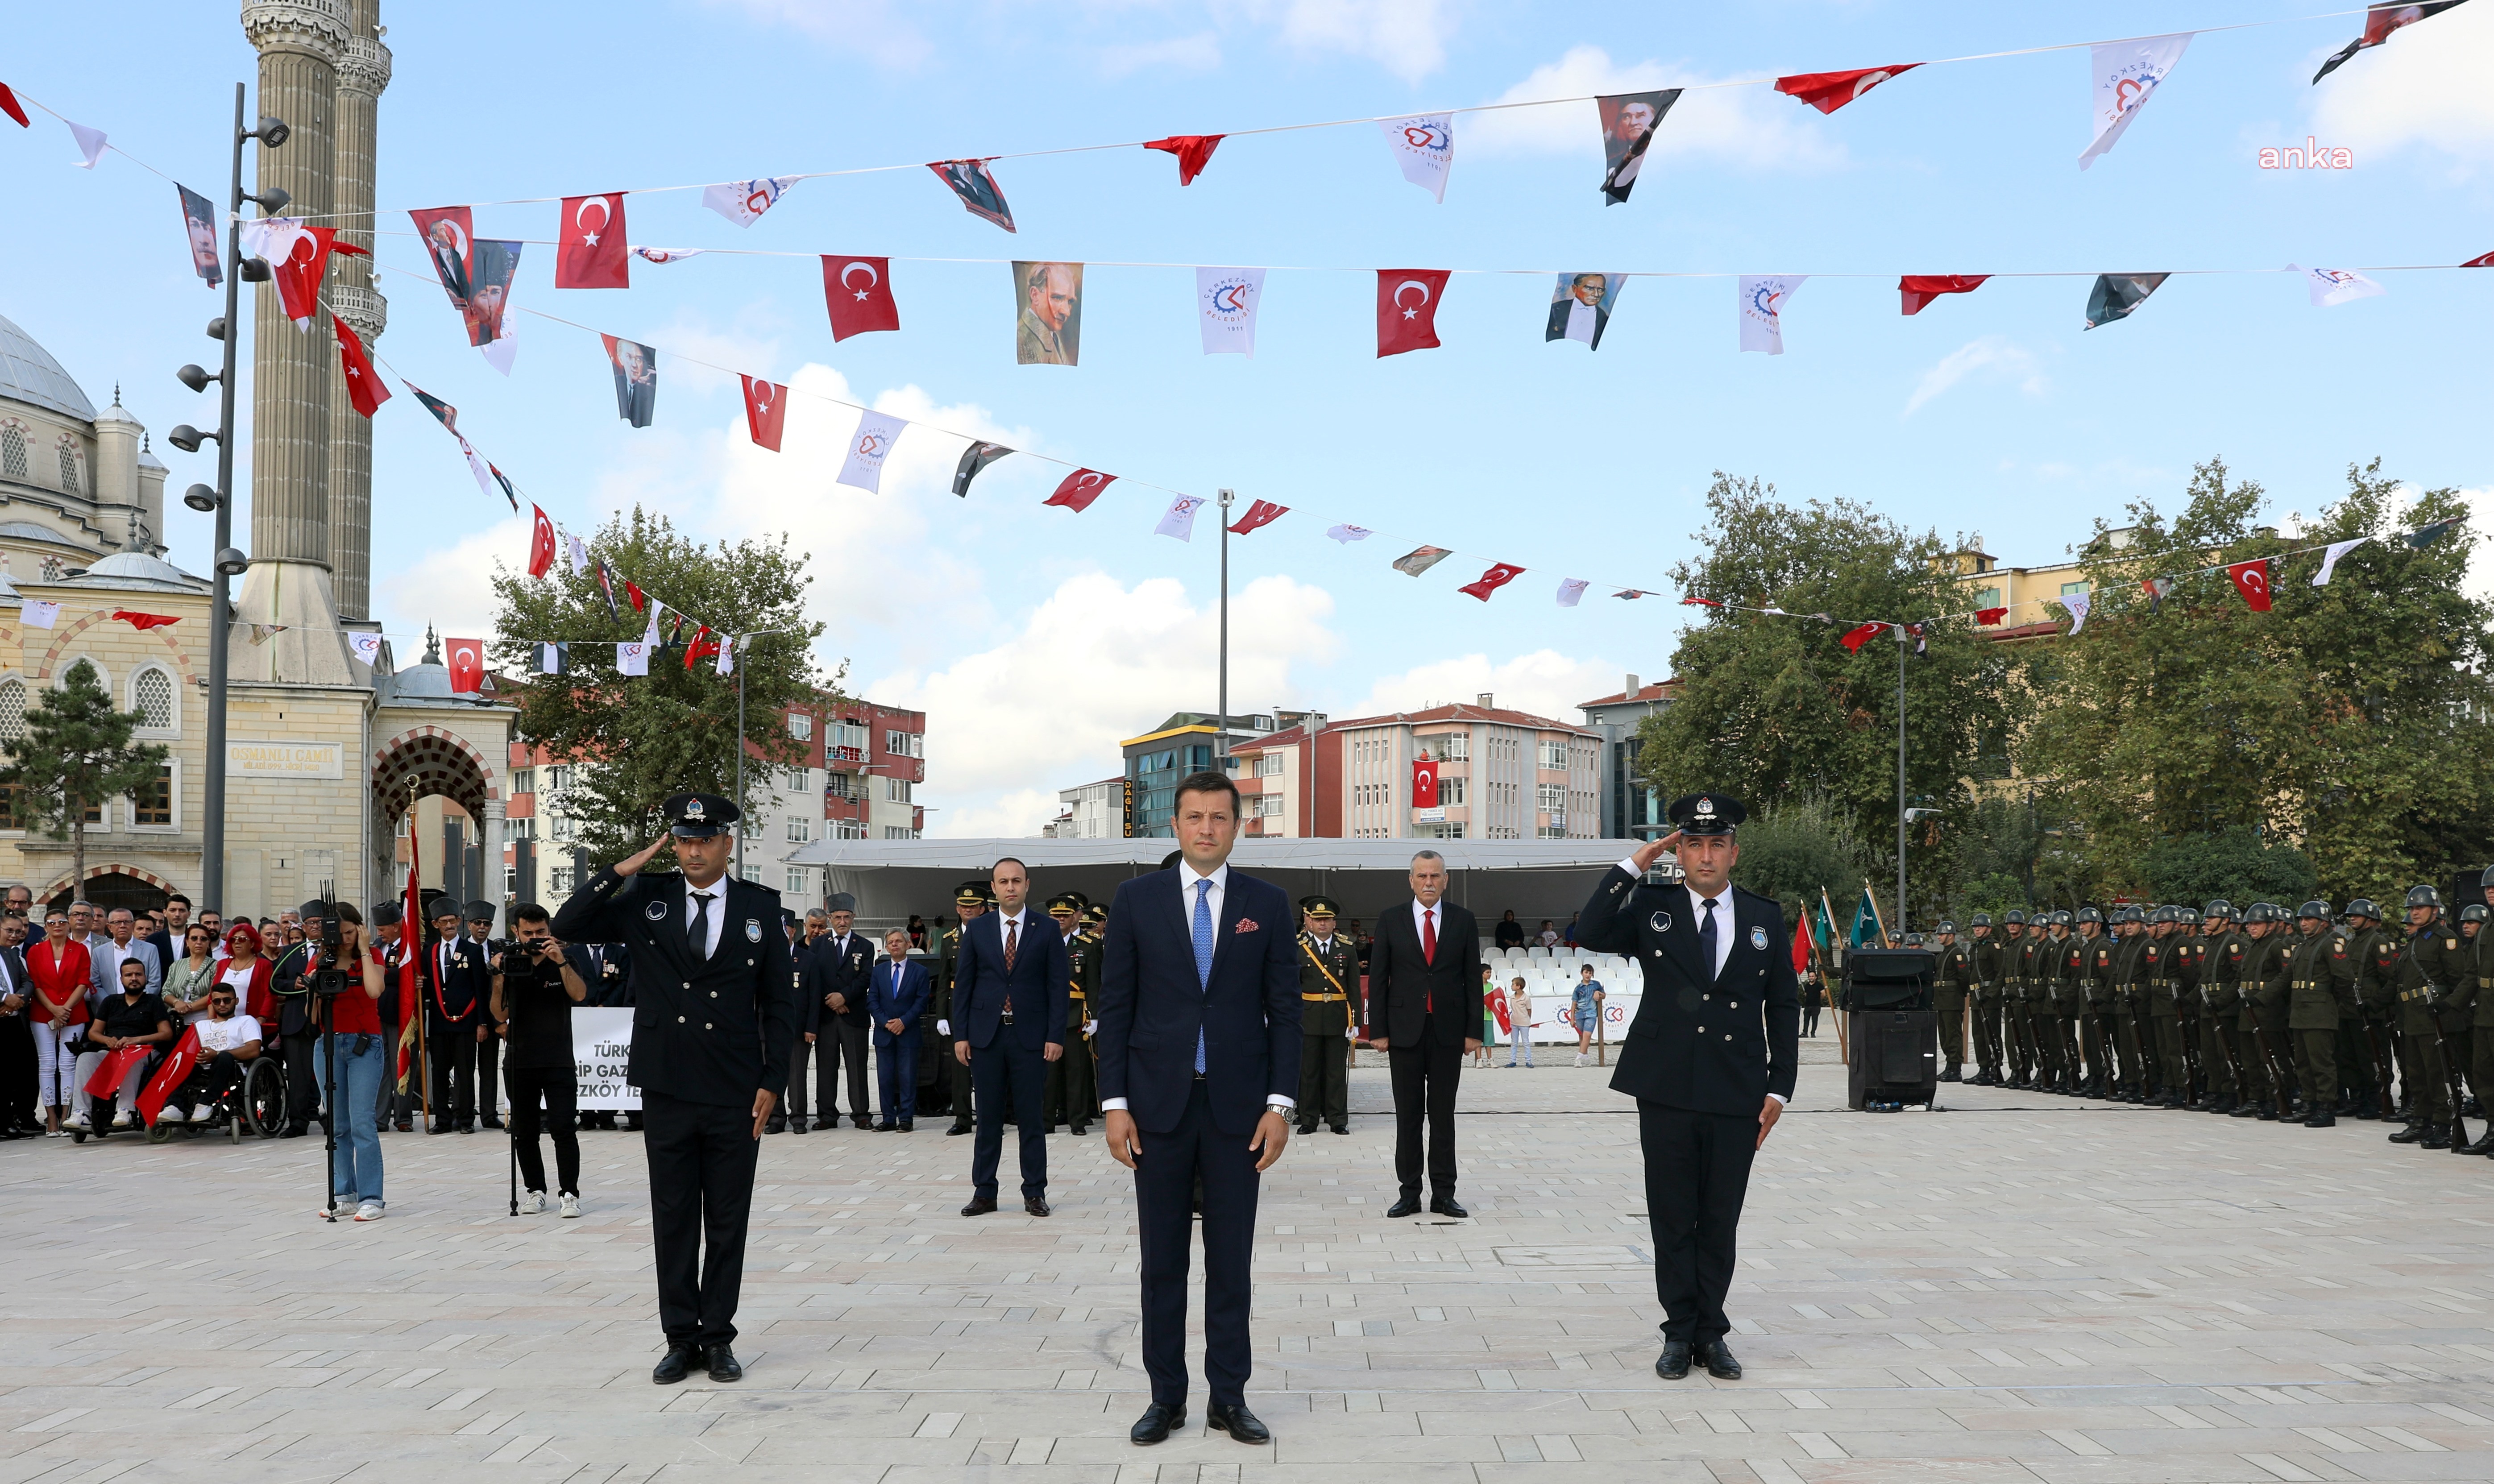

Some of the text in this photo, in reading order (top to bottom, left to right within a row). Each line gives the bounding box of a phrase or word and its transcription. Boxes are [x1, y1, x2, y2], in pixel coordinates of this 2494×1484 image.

[231, 747, 334, 763] OSMANLI CAMİİ
[1125, 823, 1131, 837] SU
[577, 1080, 622, 1097] ZKÖY
